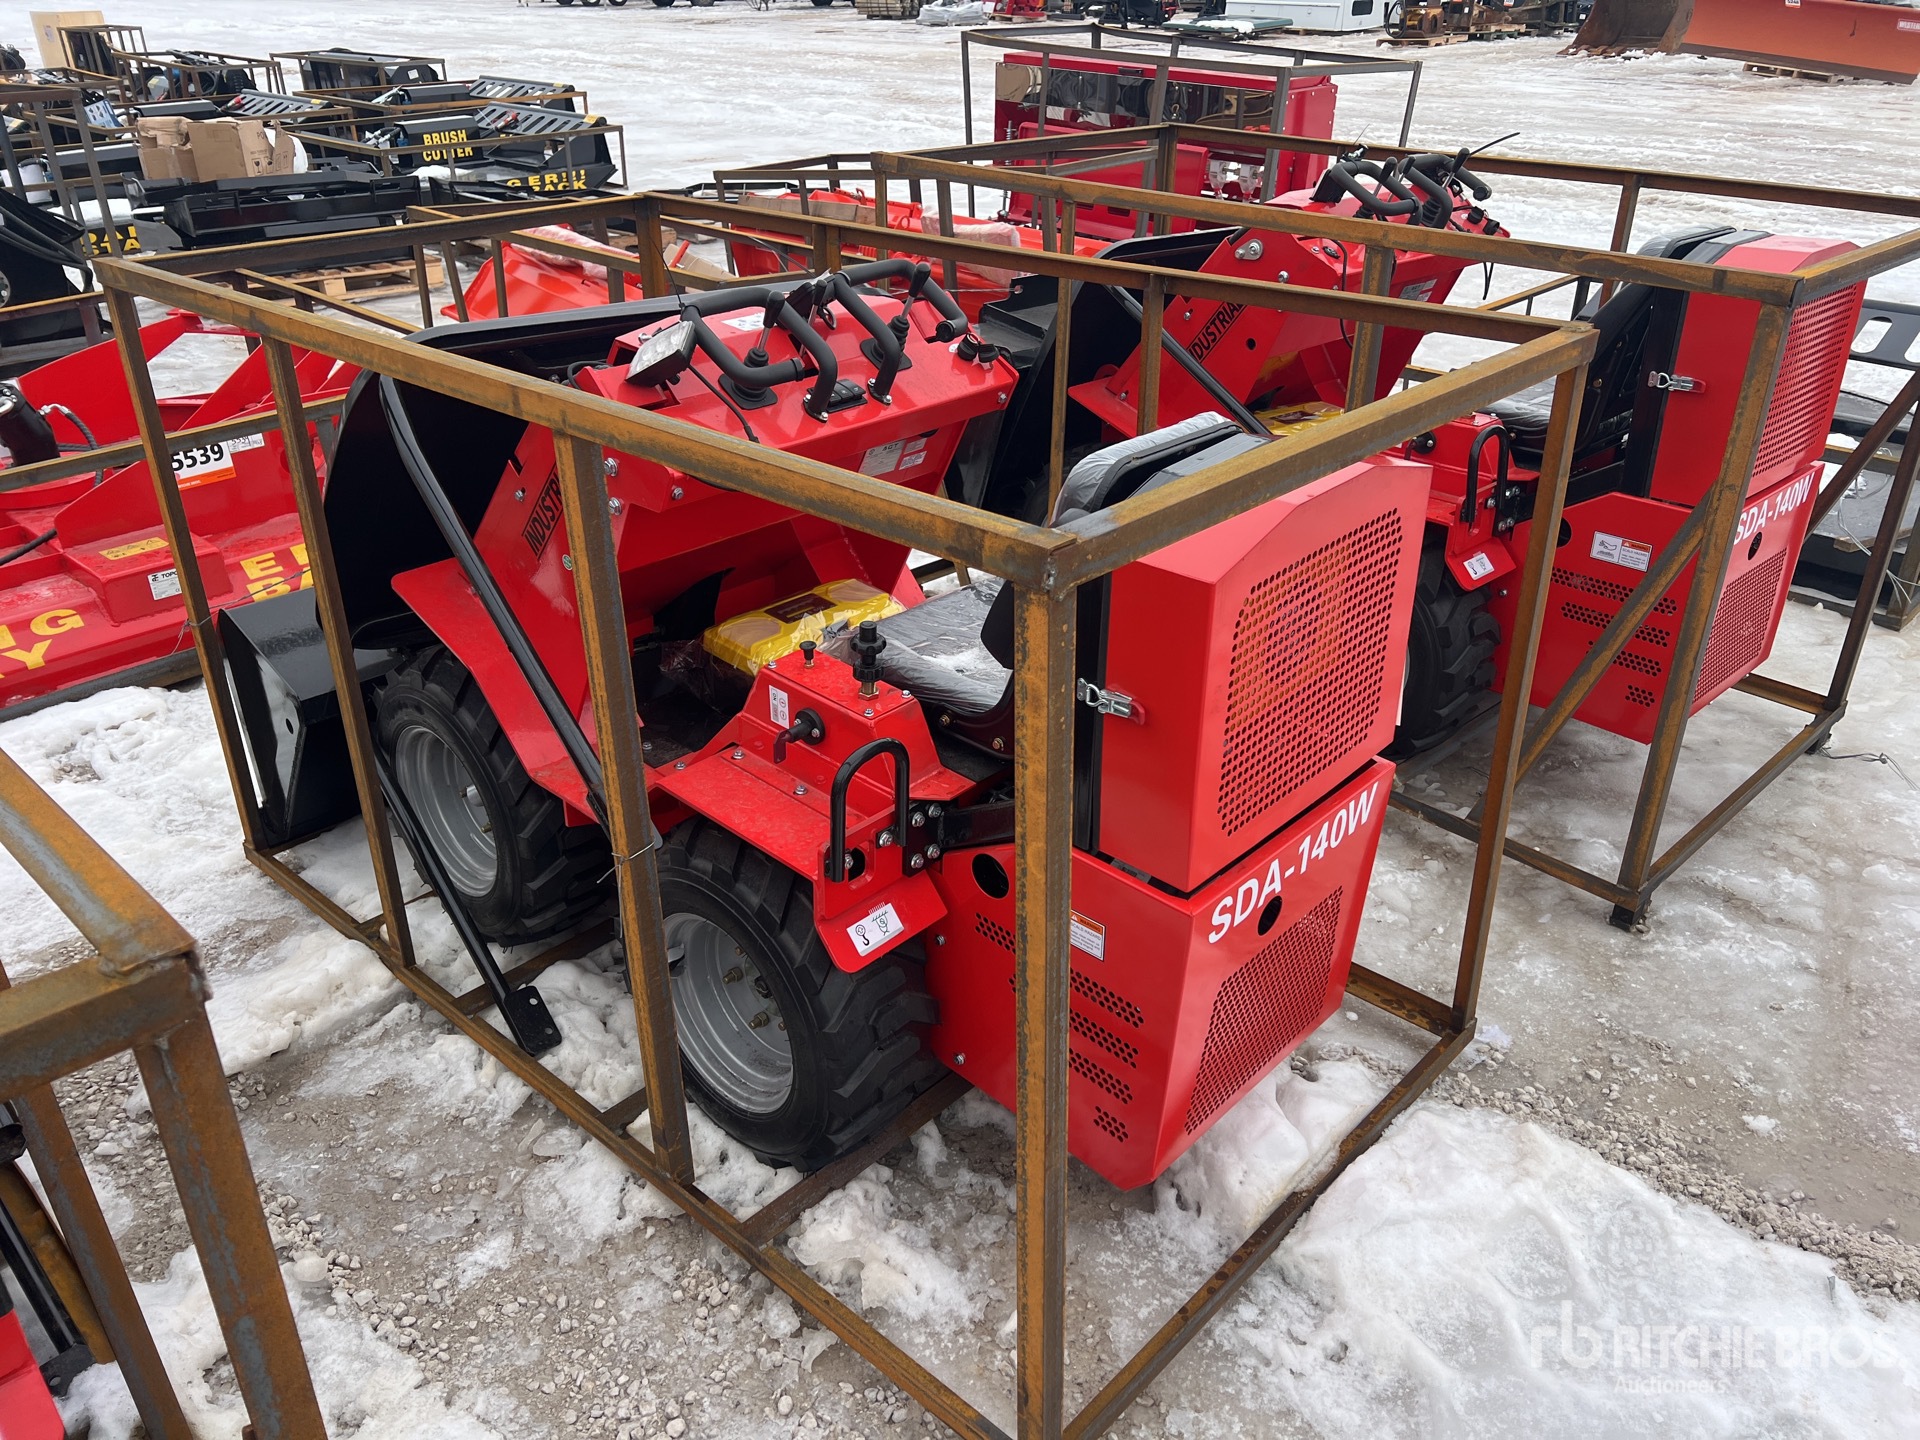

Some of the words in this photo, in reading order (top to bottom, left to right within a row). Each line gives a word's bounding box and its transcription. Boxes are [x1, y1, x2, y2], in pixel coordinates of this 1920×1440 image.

[423, 129, 467, 145] BRUSH
[1189, 303, 1243, 360] DUSTRIA
[171, 443, 224, 471] 5539
[1734, 472, 1815, 545] SDA-140W
[1208, 781, 1378, 944] SDA-140W
